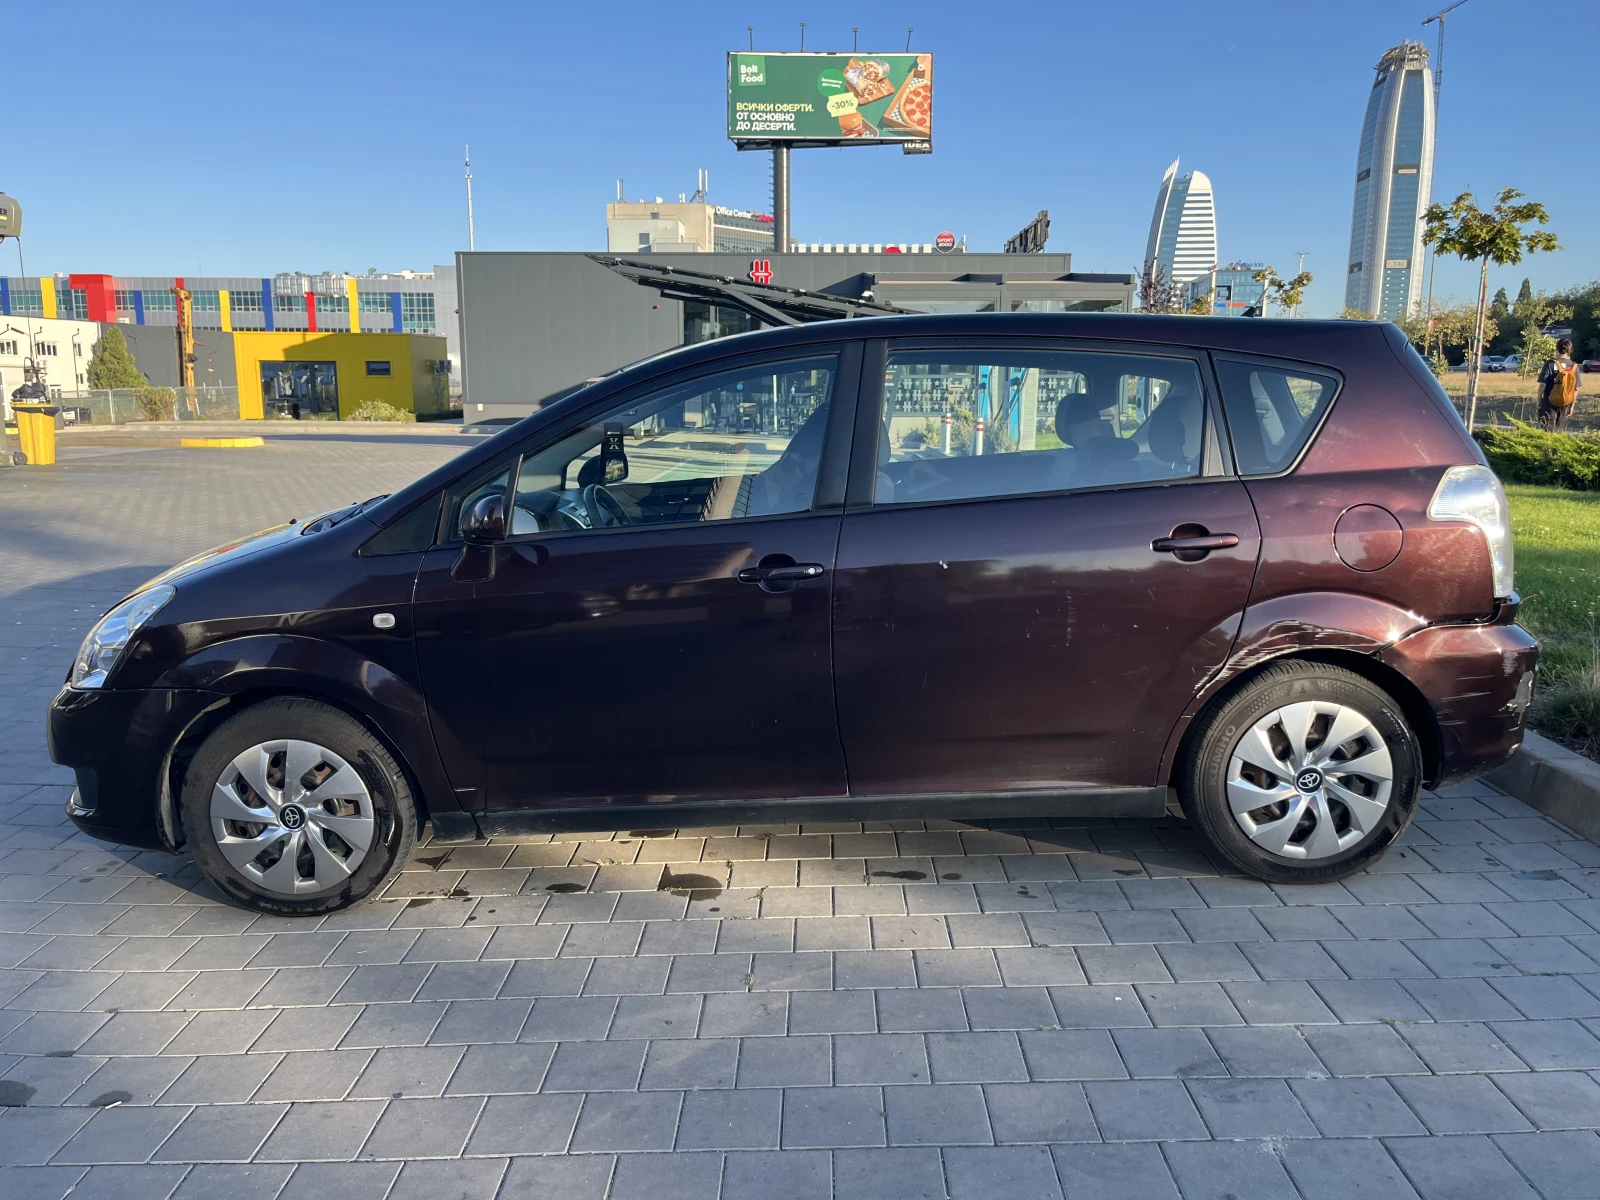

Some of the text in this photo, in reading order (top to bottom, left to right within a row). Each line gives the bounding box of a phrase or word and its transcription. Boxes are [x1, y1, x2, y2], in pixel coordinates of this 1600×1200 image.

[740, 64, 758, 75] Bolt
[741, 73, 764, 83] Food
[736, 102, 815, 112] ВСИЧКИ ОФЕРТИ.
[831, 99, 854, 110] -30%
[736, 112, 795, 122] ОТ ОСНОВНО
[735, 121, 797, 131] ДО ДЕСЕРТИ.
[716, 206, 733, 216] Office
[733, 209, 752, 219] Center
[1208, 725, 1236, 786] KUMHO
